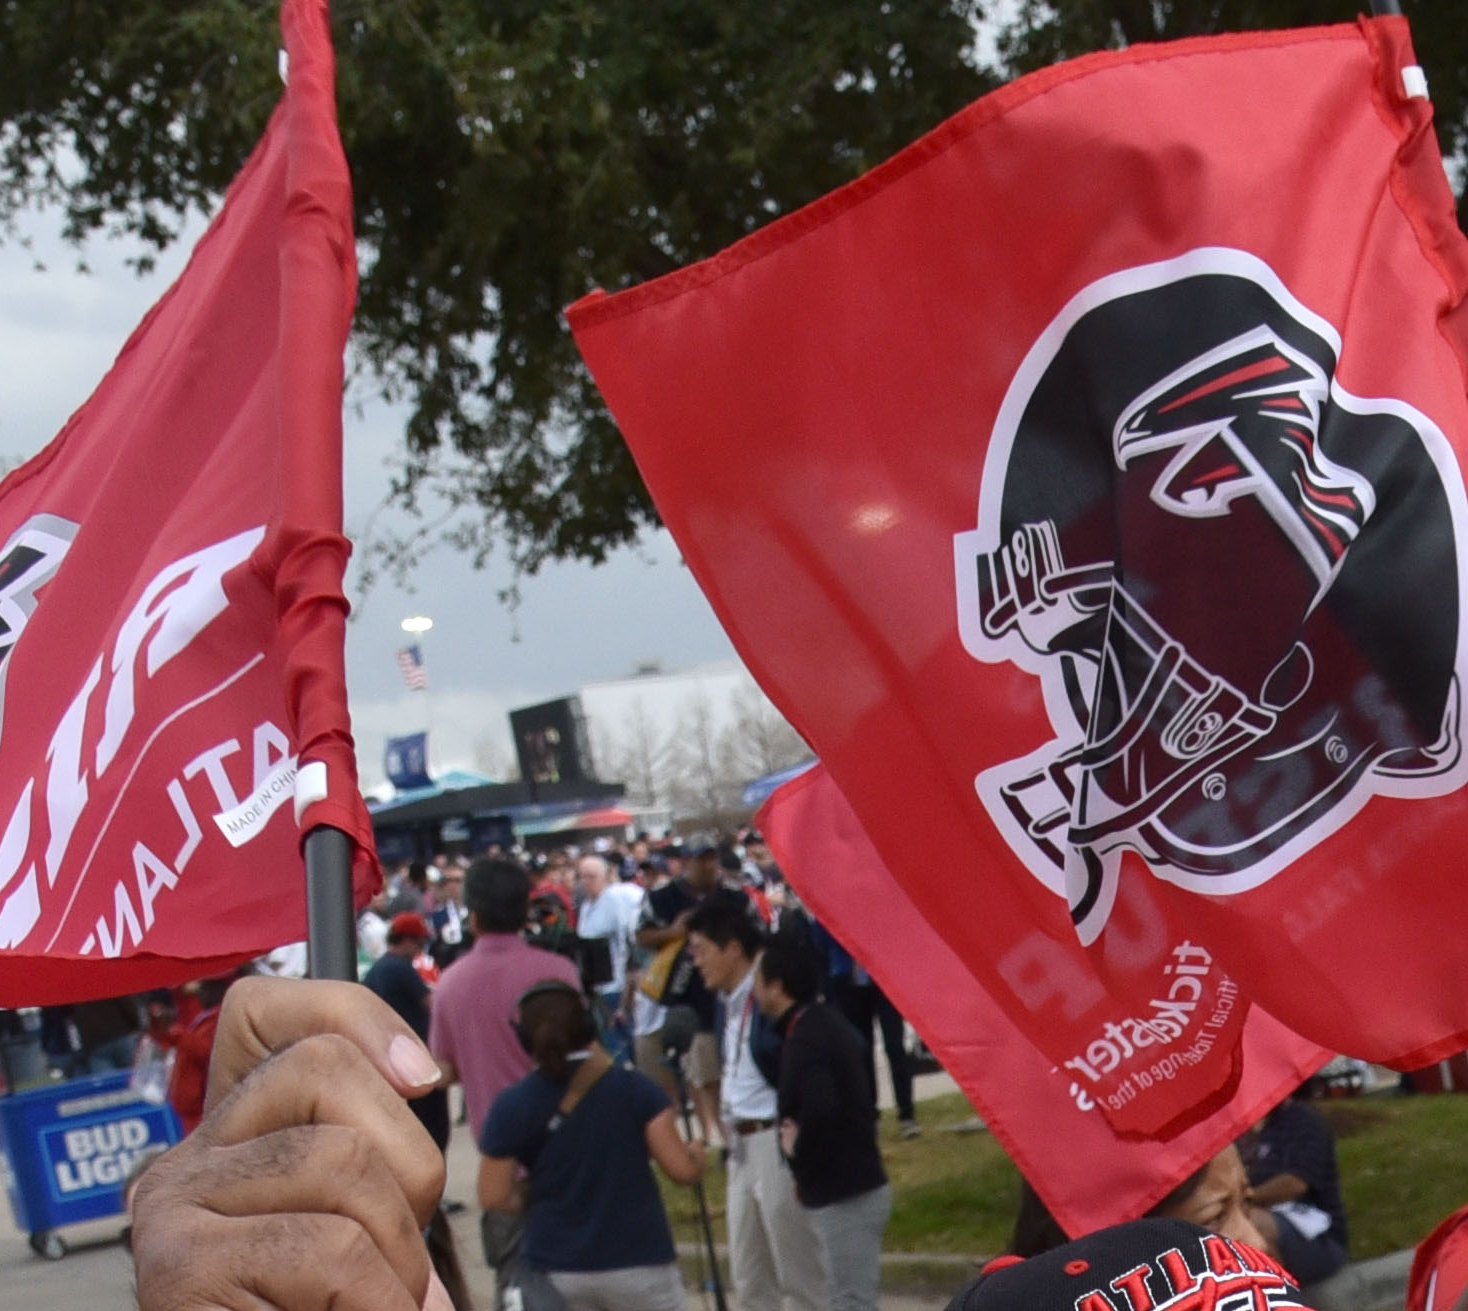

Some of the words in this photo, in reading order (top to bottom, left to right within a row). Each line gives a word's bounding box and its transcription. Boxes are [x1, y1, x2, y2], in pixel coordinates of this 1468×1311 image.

[226, 803, 262, 834] MADE
[259, 791, 272, 807] IN
[271, 768, 299, 793] CHIN
[64, 1117, 150, 1161] BUD
[55, 1150, 140, 1193] LIGH
